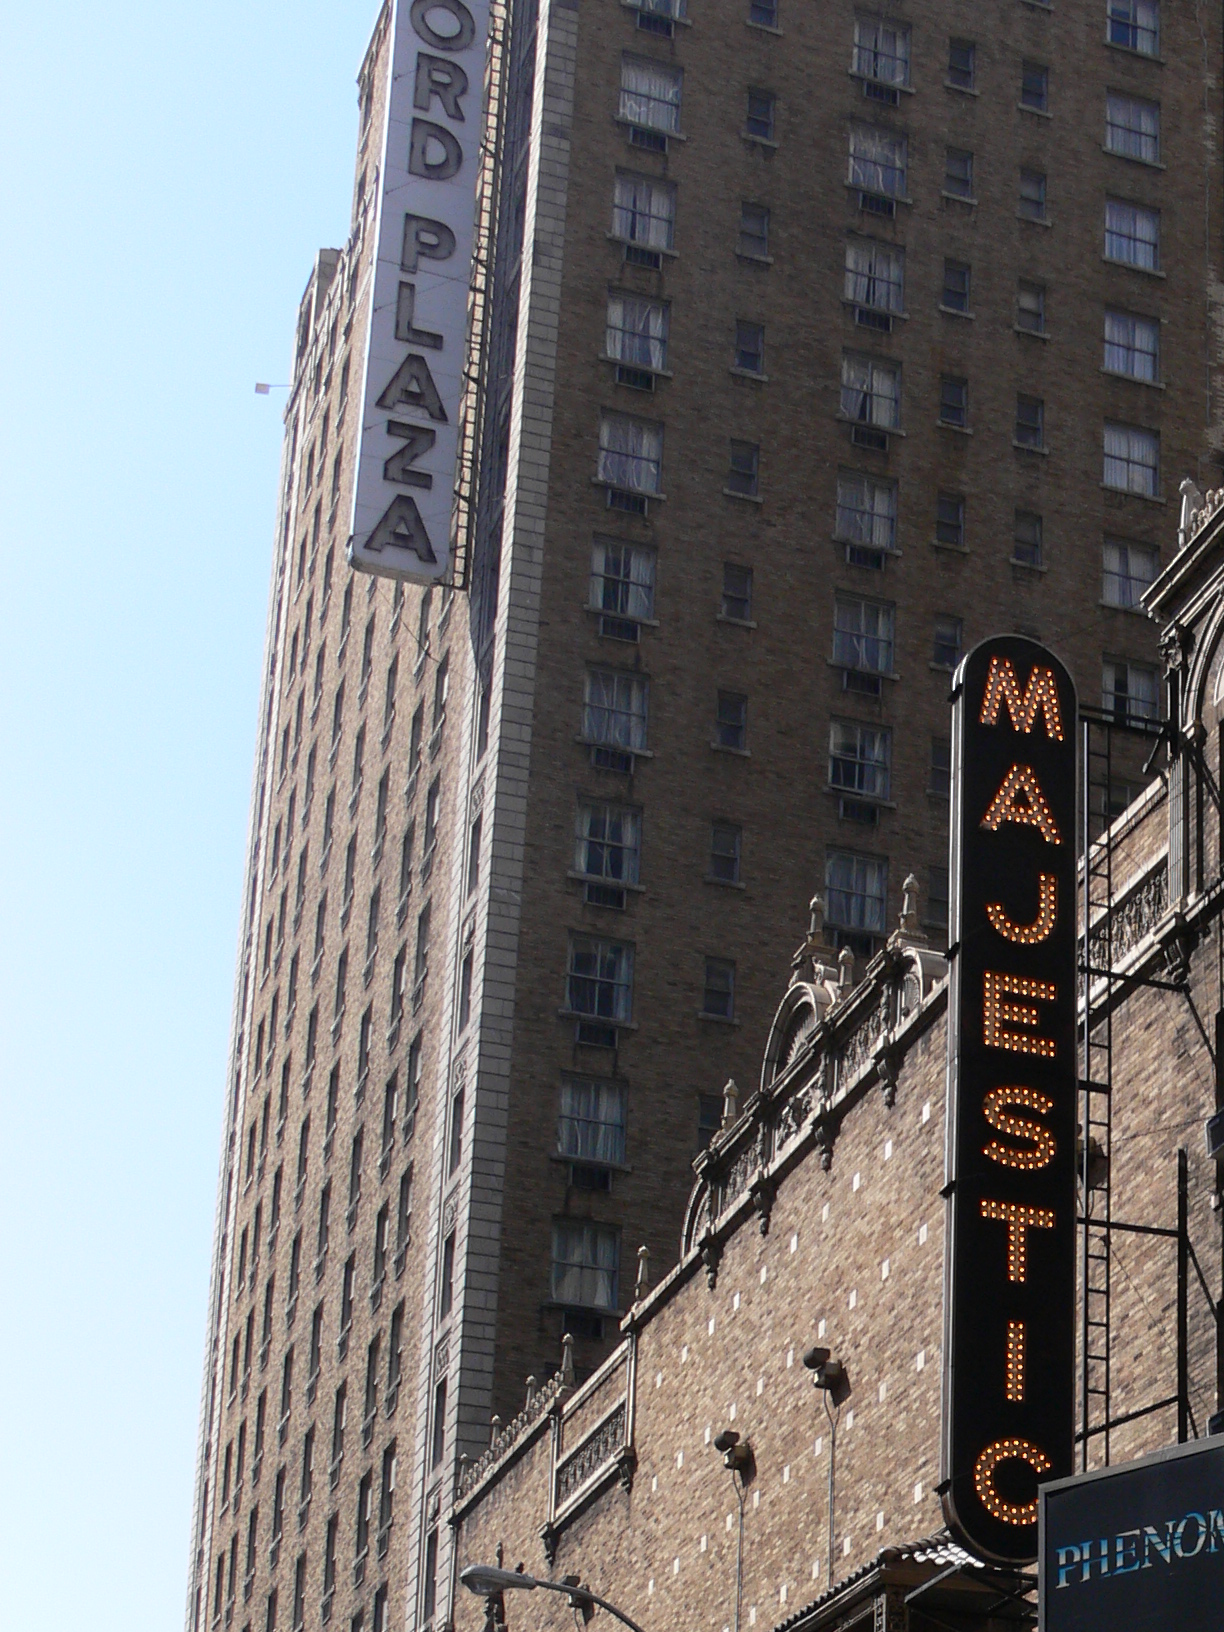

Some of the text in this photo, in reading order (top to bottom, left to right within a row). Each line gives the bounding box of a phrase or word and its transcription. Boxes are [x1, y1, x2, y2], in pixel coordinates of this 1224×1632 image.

[363, 0, 477, 565] ORD PLAZA
[972, 655, 1067, 1526] MAJESTIC
